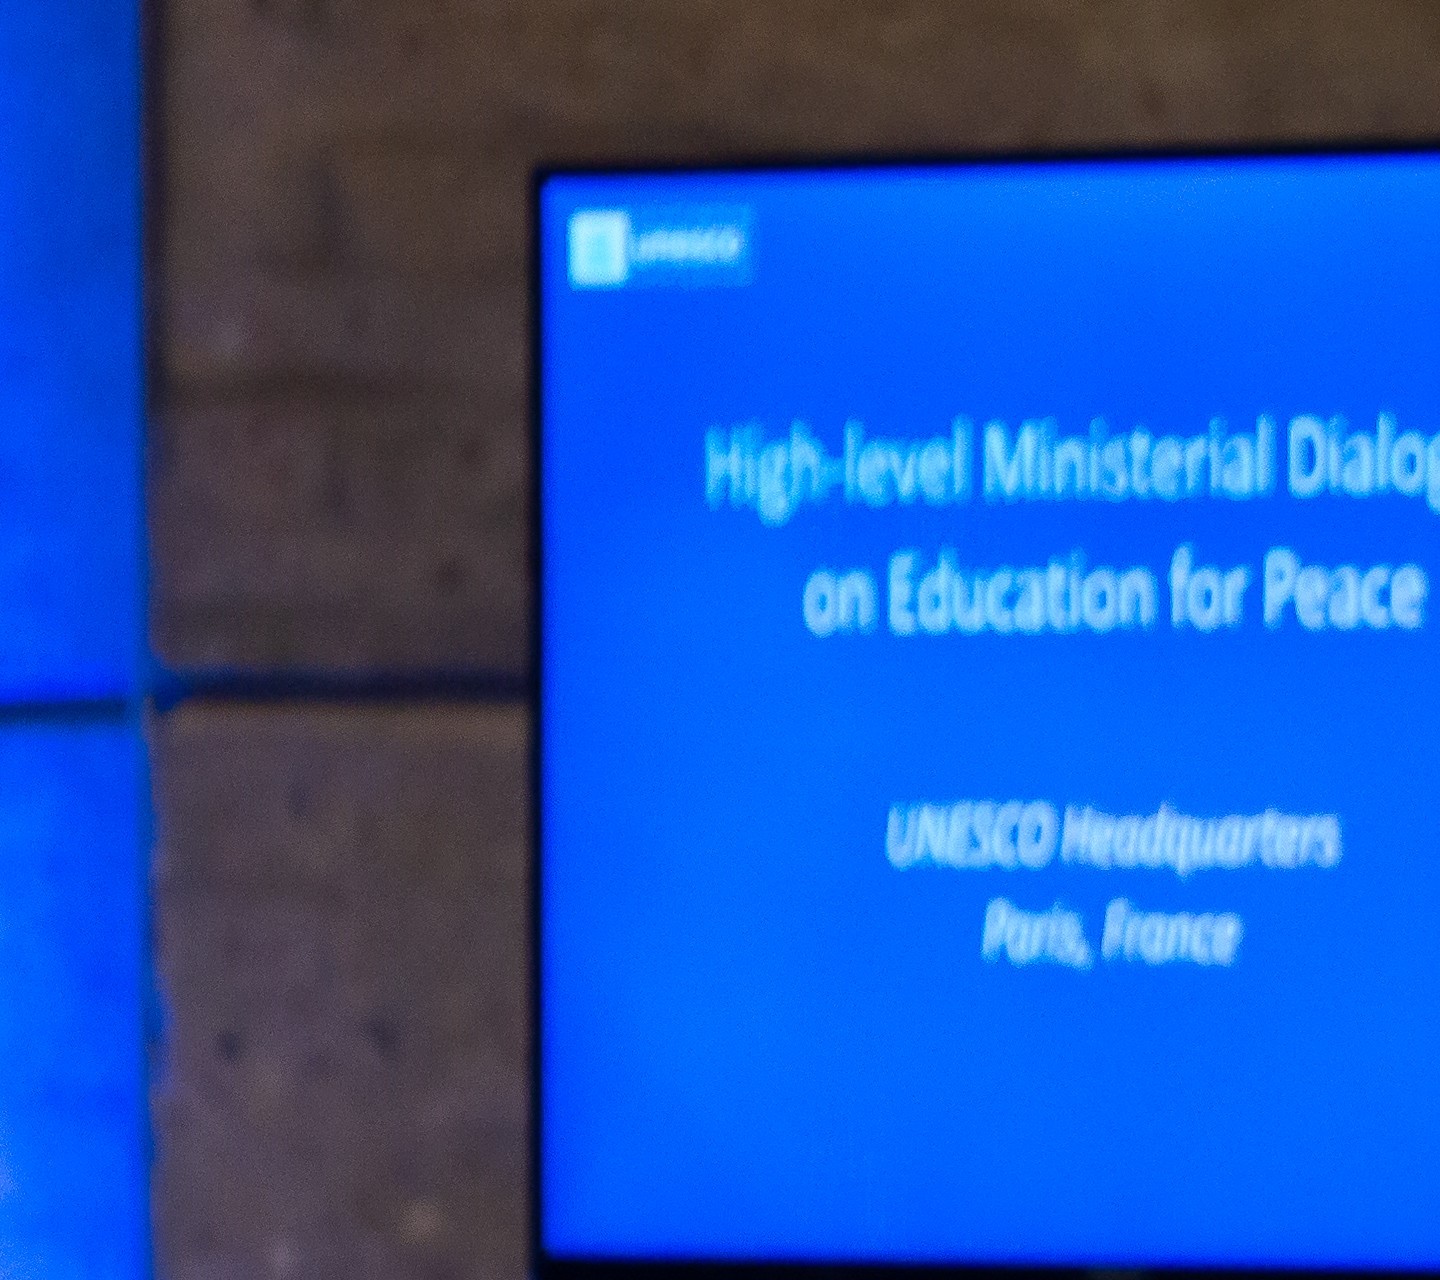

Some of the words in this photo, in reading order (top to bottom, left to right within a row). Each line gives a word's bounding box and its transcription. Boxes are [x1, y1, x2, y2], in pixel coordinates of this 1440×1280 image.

[707, 415, 967, 521] High-level
[984, 415, 1273, 501] Ministerial
[803, 568, 876, 637] on
[888, 549, 1156, 636] Education
[1169, 544, 1248, 631] for
[1263, 547, 1428, 631] Peace
[886, 801, 1060, 871] UNESCO
[1060, 801, 1343, 880] Headquarters
[981, 897, 1093, 970] Paris,
[1100, 897, 1244, 967] France
